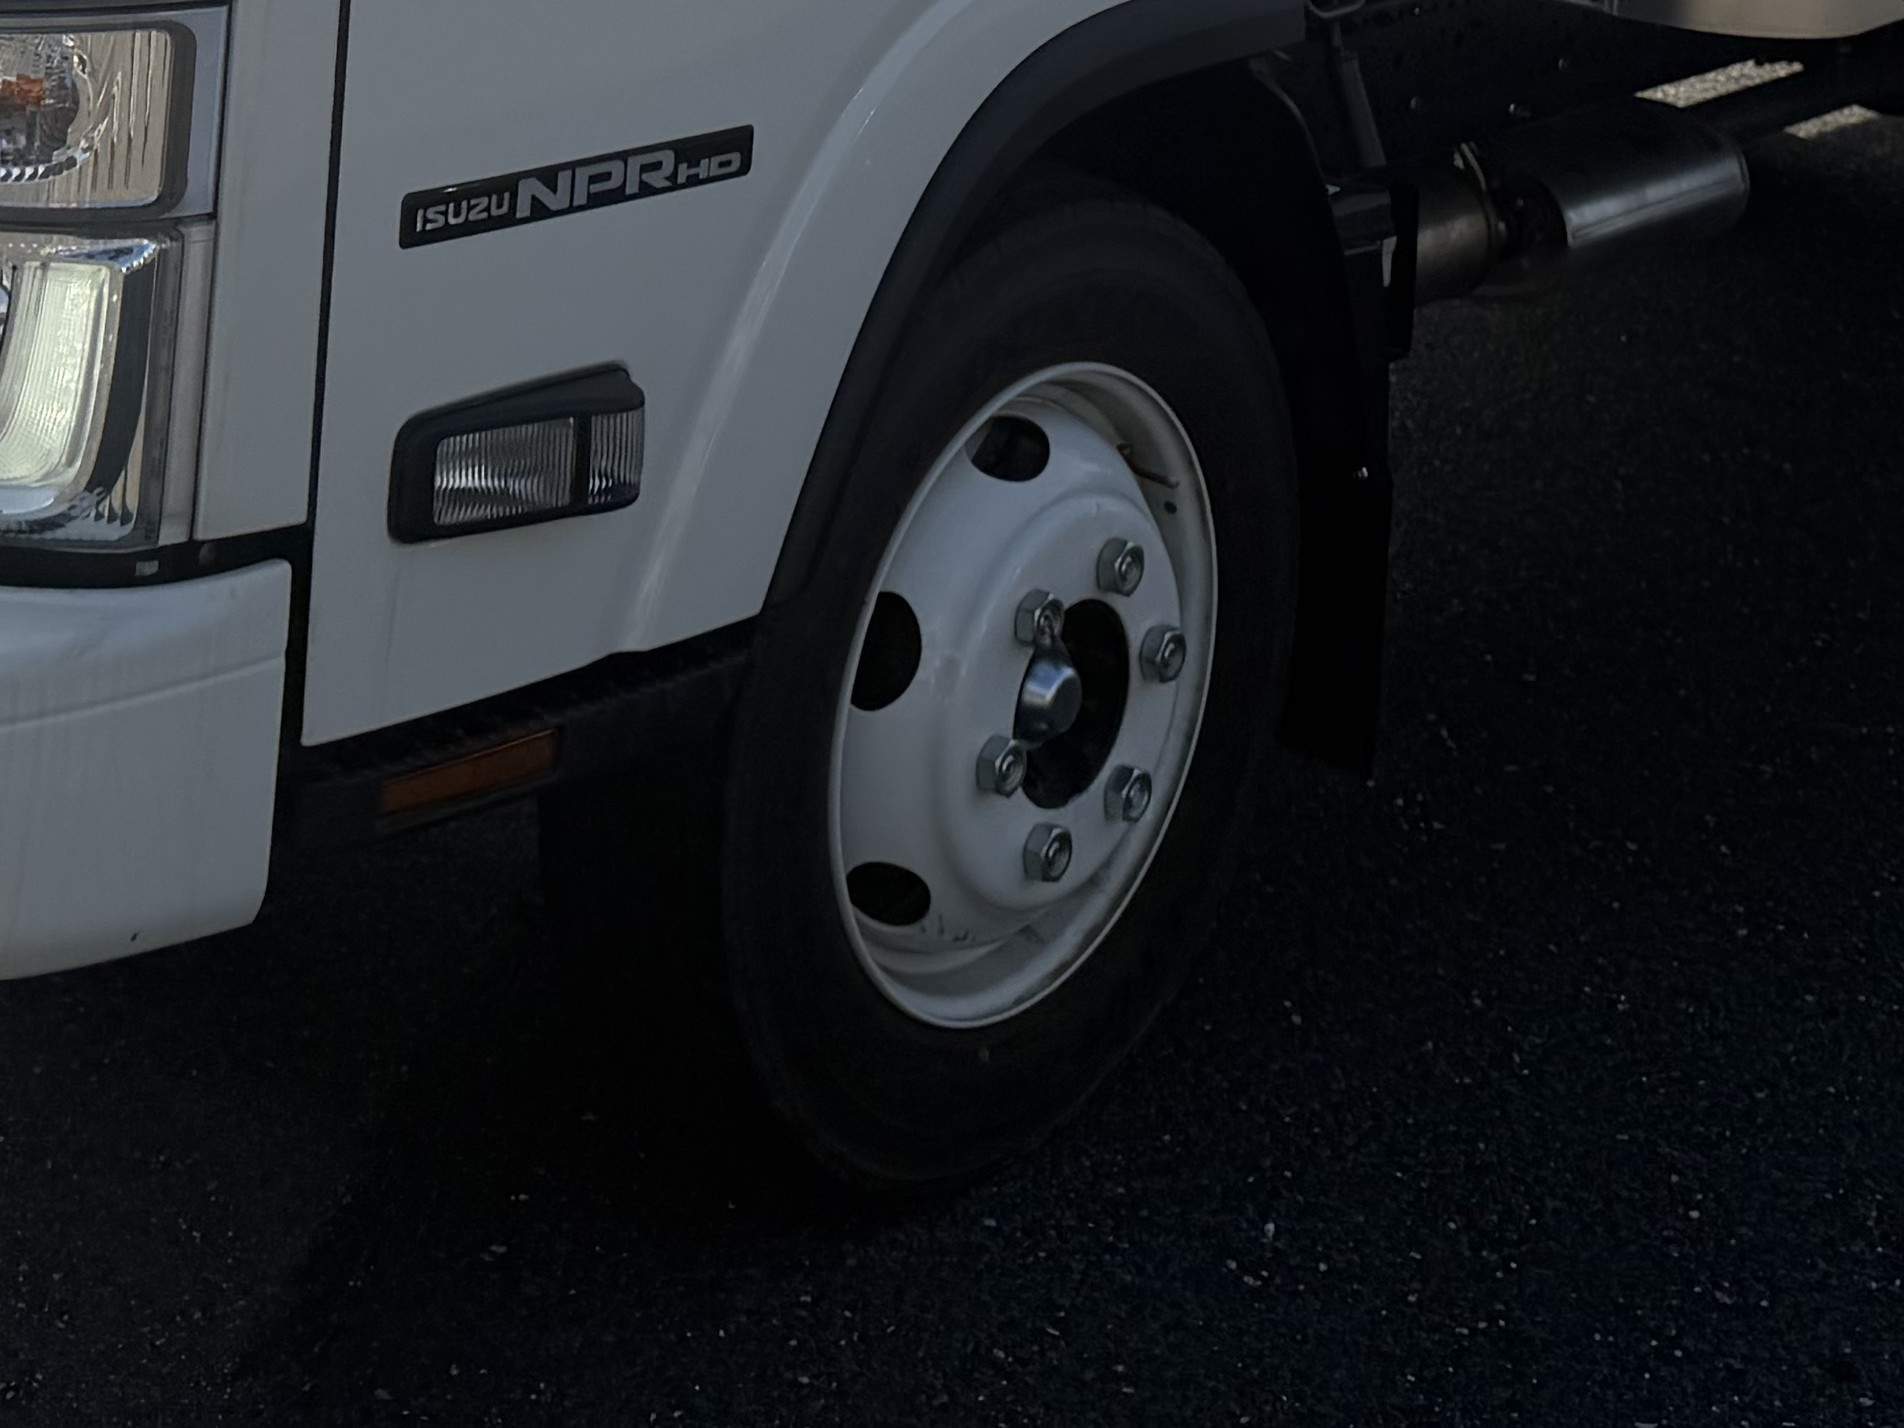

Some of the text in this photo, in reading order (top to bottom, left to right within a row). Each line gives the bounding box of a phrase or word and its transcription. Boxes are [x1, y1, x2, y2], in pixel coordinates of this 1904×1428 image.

[416, 149, 742, 233] ISUZU NPR HD
